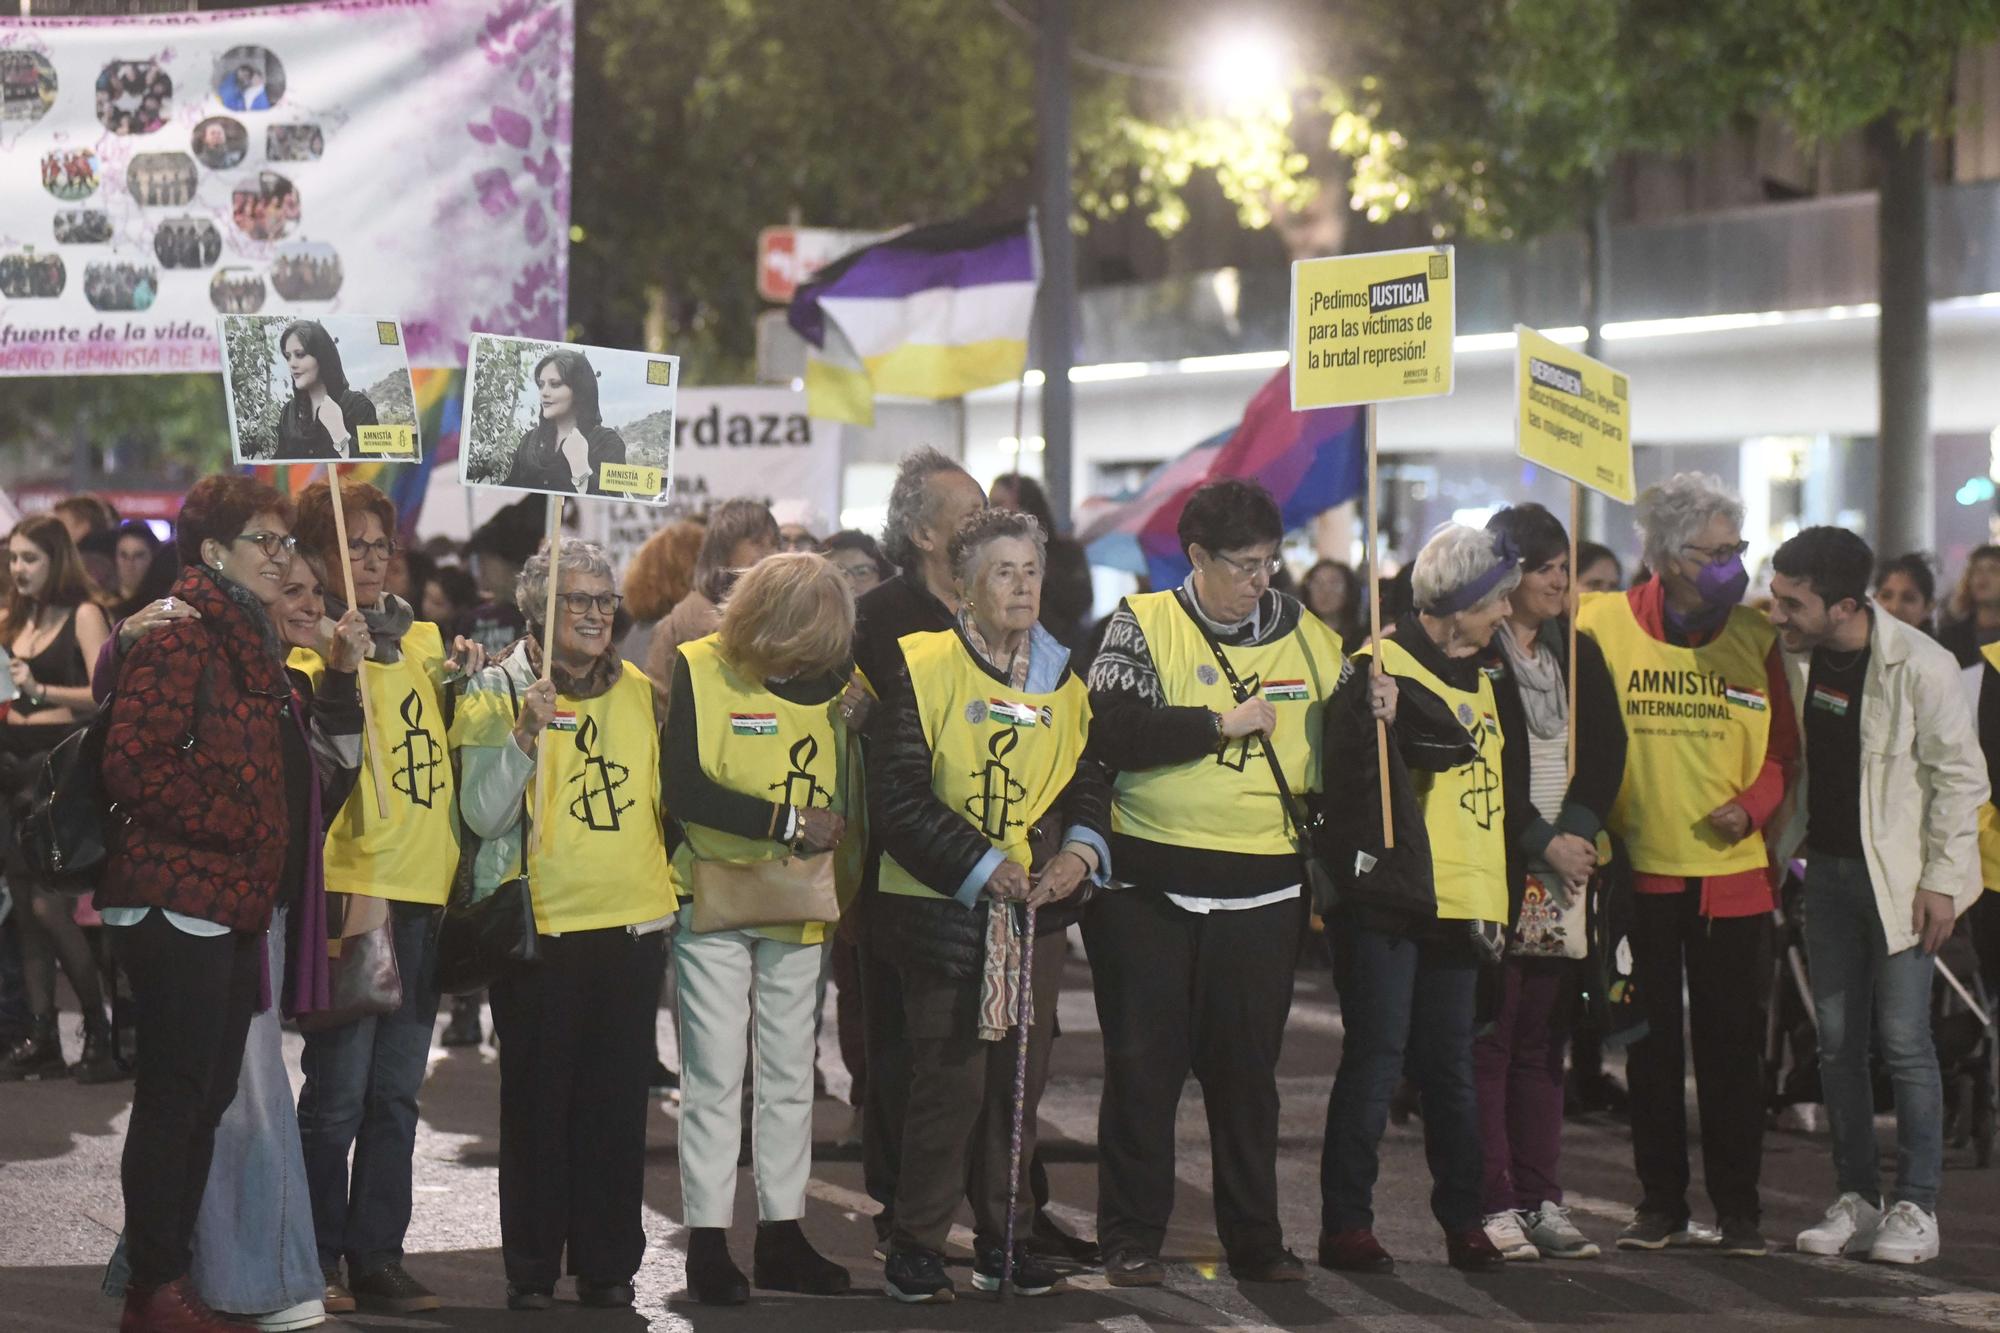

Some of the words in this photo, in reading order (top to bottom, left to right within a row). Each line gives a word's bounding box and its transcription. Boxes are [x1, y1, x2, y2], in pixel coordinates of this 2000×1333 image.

[1309, 290, 1368, 316] ¡Pedimos
[1371, 282, 1426, 307] JUSTICIA
[2, 323, 81, 346] fuente
[88, 322, 116, 343] de
[124, 322, 146, 342] la
[154, 321, 213, 342] vida,
[1308, 324, 1338, 345] para
[1341, 318, 1359, 338] las
[1362, 314, 1414, 336] víctimas
[1417, 311, 1433, 331] de
[63, 347, 161, 370] FEMINISTA
[168, 346, 193, 367] DE
[1308, 350, 1320, 370] la
[1323, 346, 1360, 369] brutal
[1363, 340, 1426, 367] represión!
[1528, 408, 1542, 429] las
[363, 430, 392, 440] AMNISTÍA
[1601, 421, 1622, 442] para
[606, 469, 639, 481] AMNISTÍA
[1627, 669, 1728, 700] AMNISTÍA
[1626, 699, 1732, 720] INTERNACIONAL
